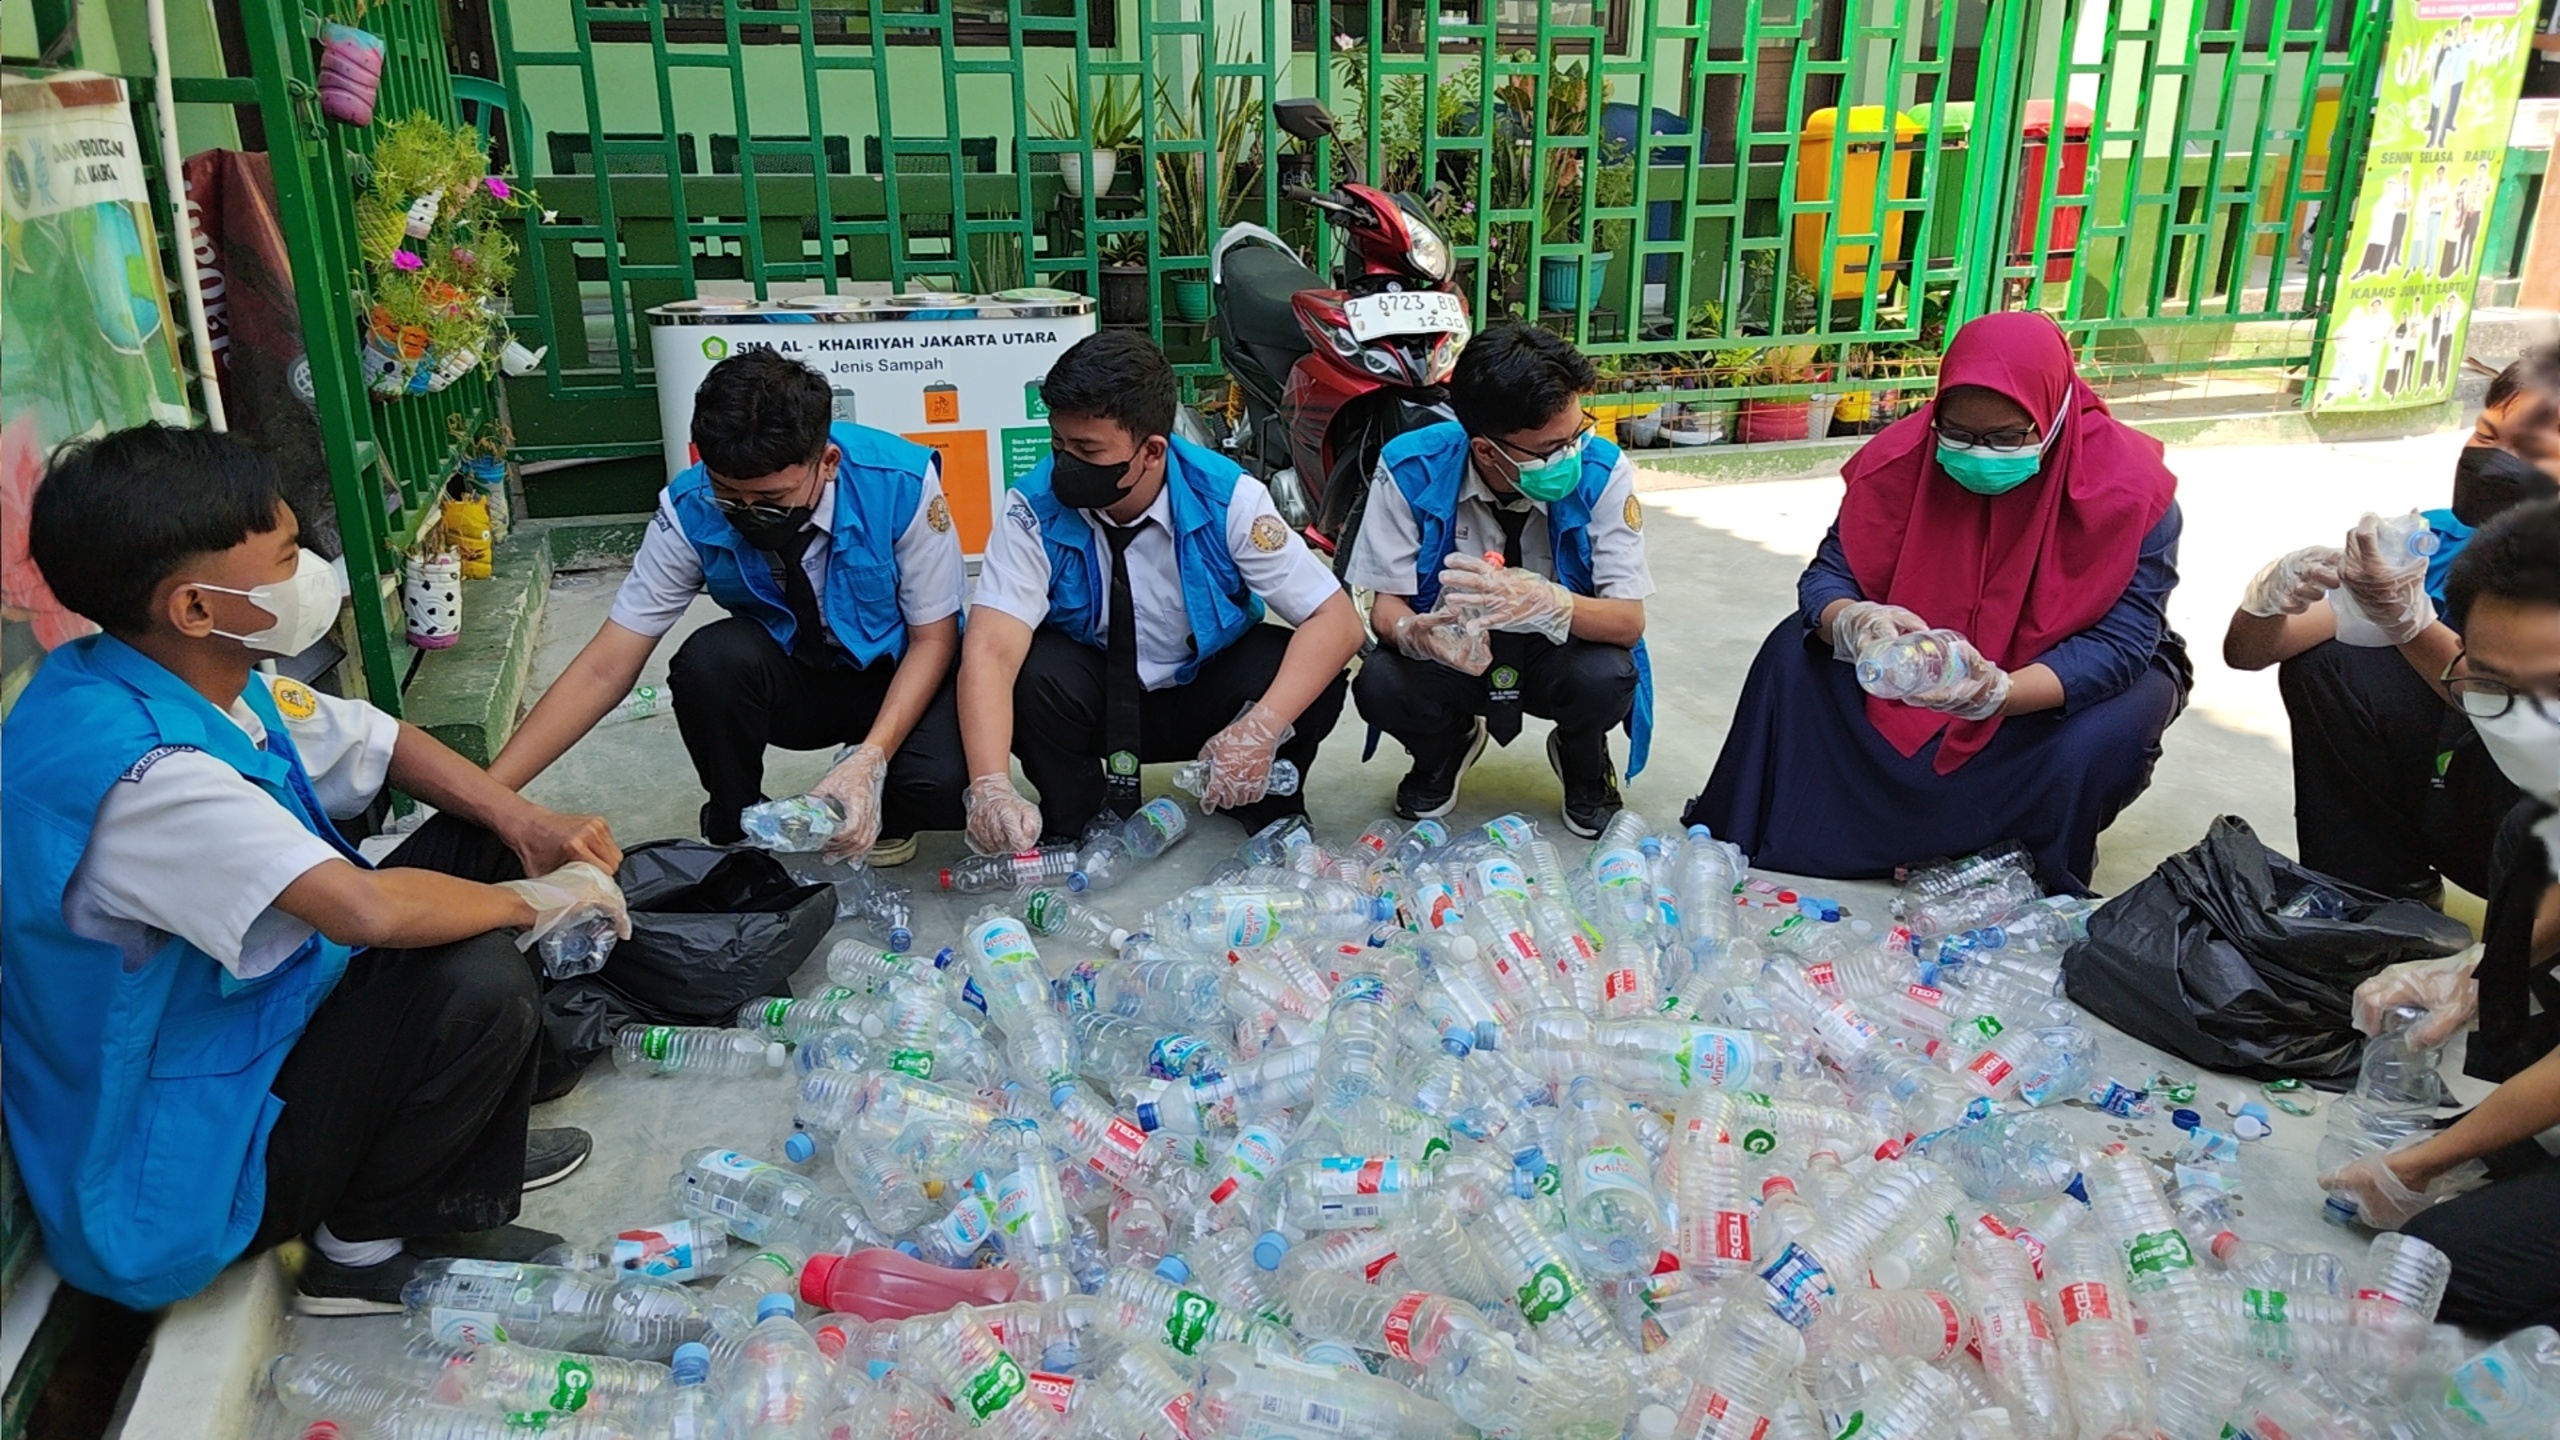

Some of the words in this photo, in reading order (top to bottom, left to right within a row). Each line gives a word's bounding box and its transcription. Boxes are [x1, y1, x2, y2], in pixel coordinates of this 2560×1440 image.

[2381, 152, 2413, 164] SENIN
[2420, 151, 2453, 163] SELASA
[2464, 150, 2495, 162] RABU
[2350, 287, 2396, 299] KAMIS
[2435, 281, 2468, 294] SABTU
[1348, 301, 1362, 318] Z
[1378, 294, 1426, 311] 6723
[736, 341, 773, 354] SMA
[780, 340, 803, 353] AL
[818, 336, 914, 352] KHAIRIYAH
[920, 334, 998, 349] JAKARTA
[1002, 331, 1058, 346] UTARA
[830, 358, 873, 374] Jenis
[878, 356, 944, 374] Sampah
[1700, 1053, 1714, 1069] Le
[1113, 1120, 1146, 1145] TED'S
[1728, 1214, 1742, 1259] TED'S
[2133, 1238, 2187, 1263] Gracia
[2072, 1282, 2093, 1320] TED'S
[1177, 1297, 1207, 1350] Gracia
[976, 1361, 1021, 1409] Gracia
